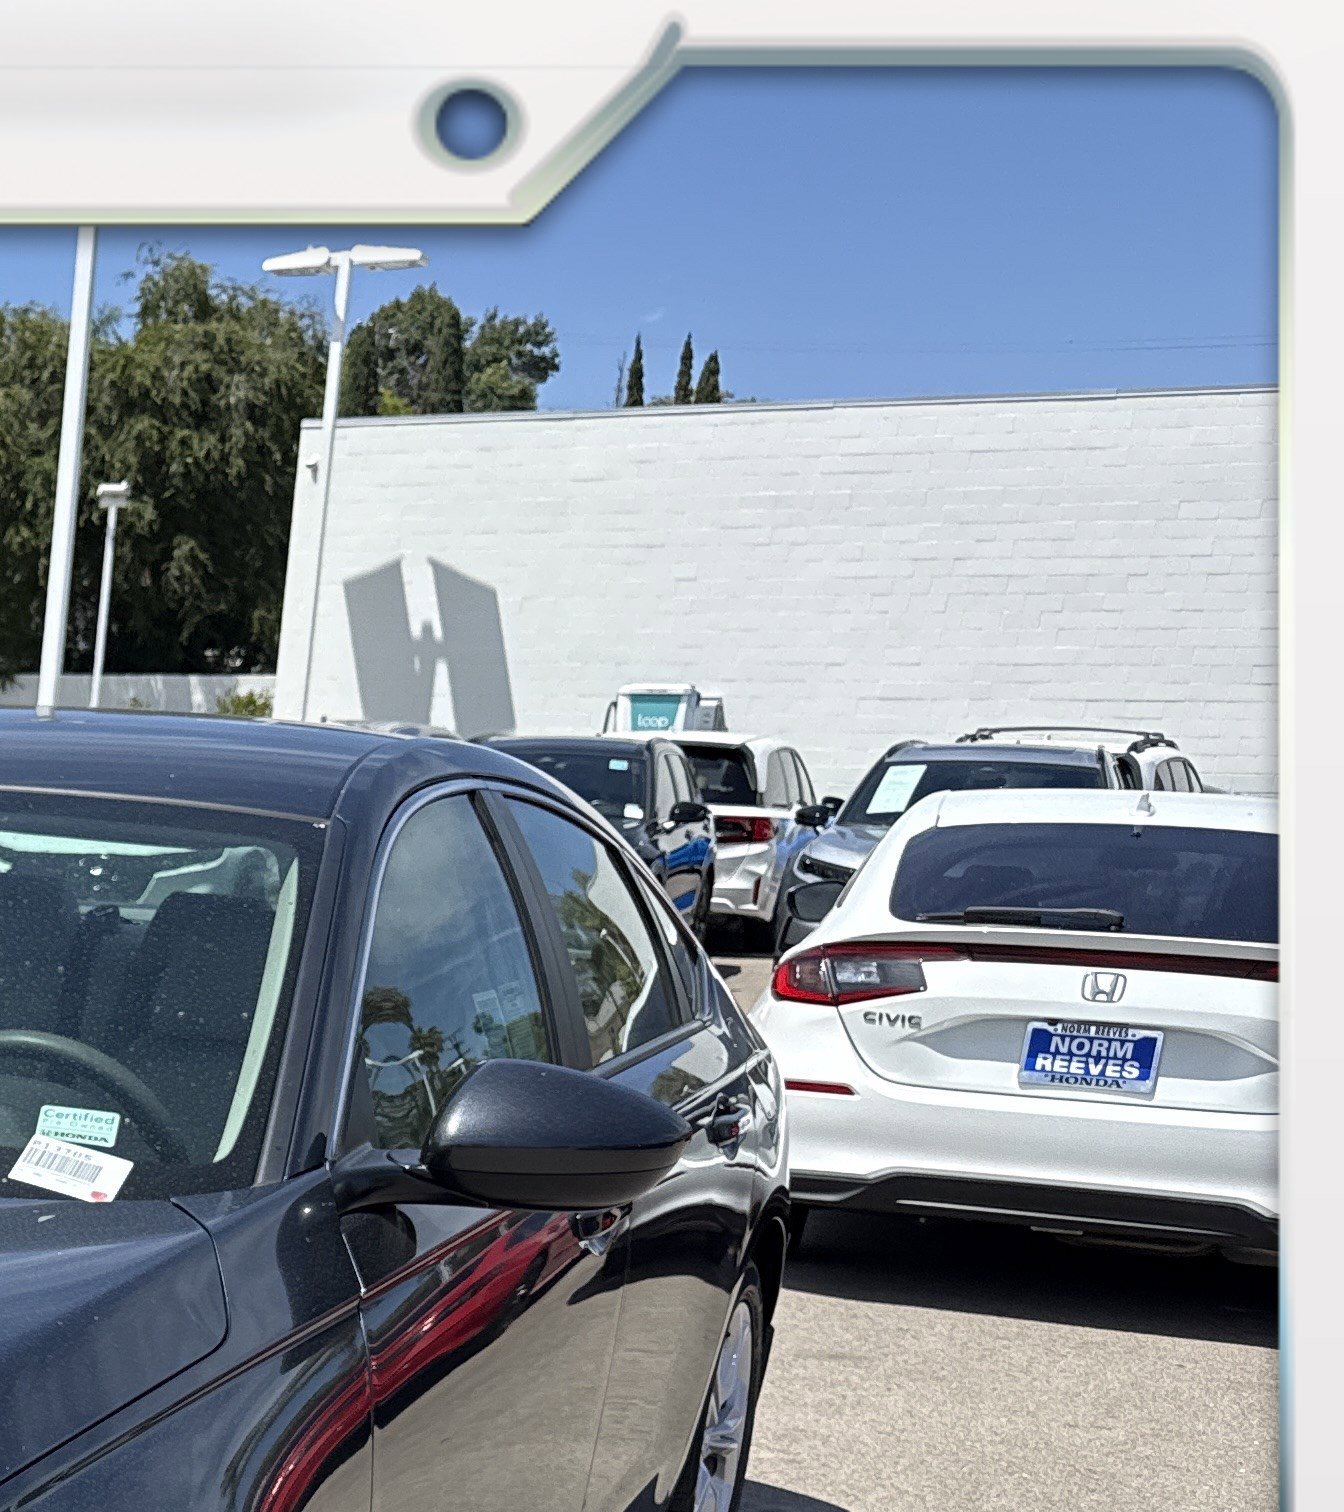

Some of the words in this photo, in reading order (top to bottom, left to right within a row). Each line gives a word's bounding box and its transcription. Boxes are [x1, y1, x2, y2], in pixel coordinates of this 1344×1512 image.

[863, 1011, 922, 1029] CIVIC
[1060, 1023, 1091, 1034] NORM
[1095, 1026, 1130, 1038] REEVES
[1050, 1035, 1135, 1059] NORM
[1034, 1053, 1140, 1079] REEVES
[1048, 1073, 1124, 1089] HONDA
[44, 1108, 115, 1125] Certified
[54, 1131, 109, 1143] HONDA
